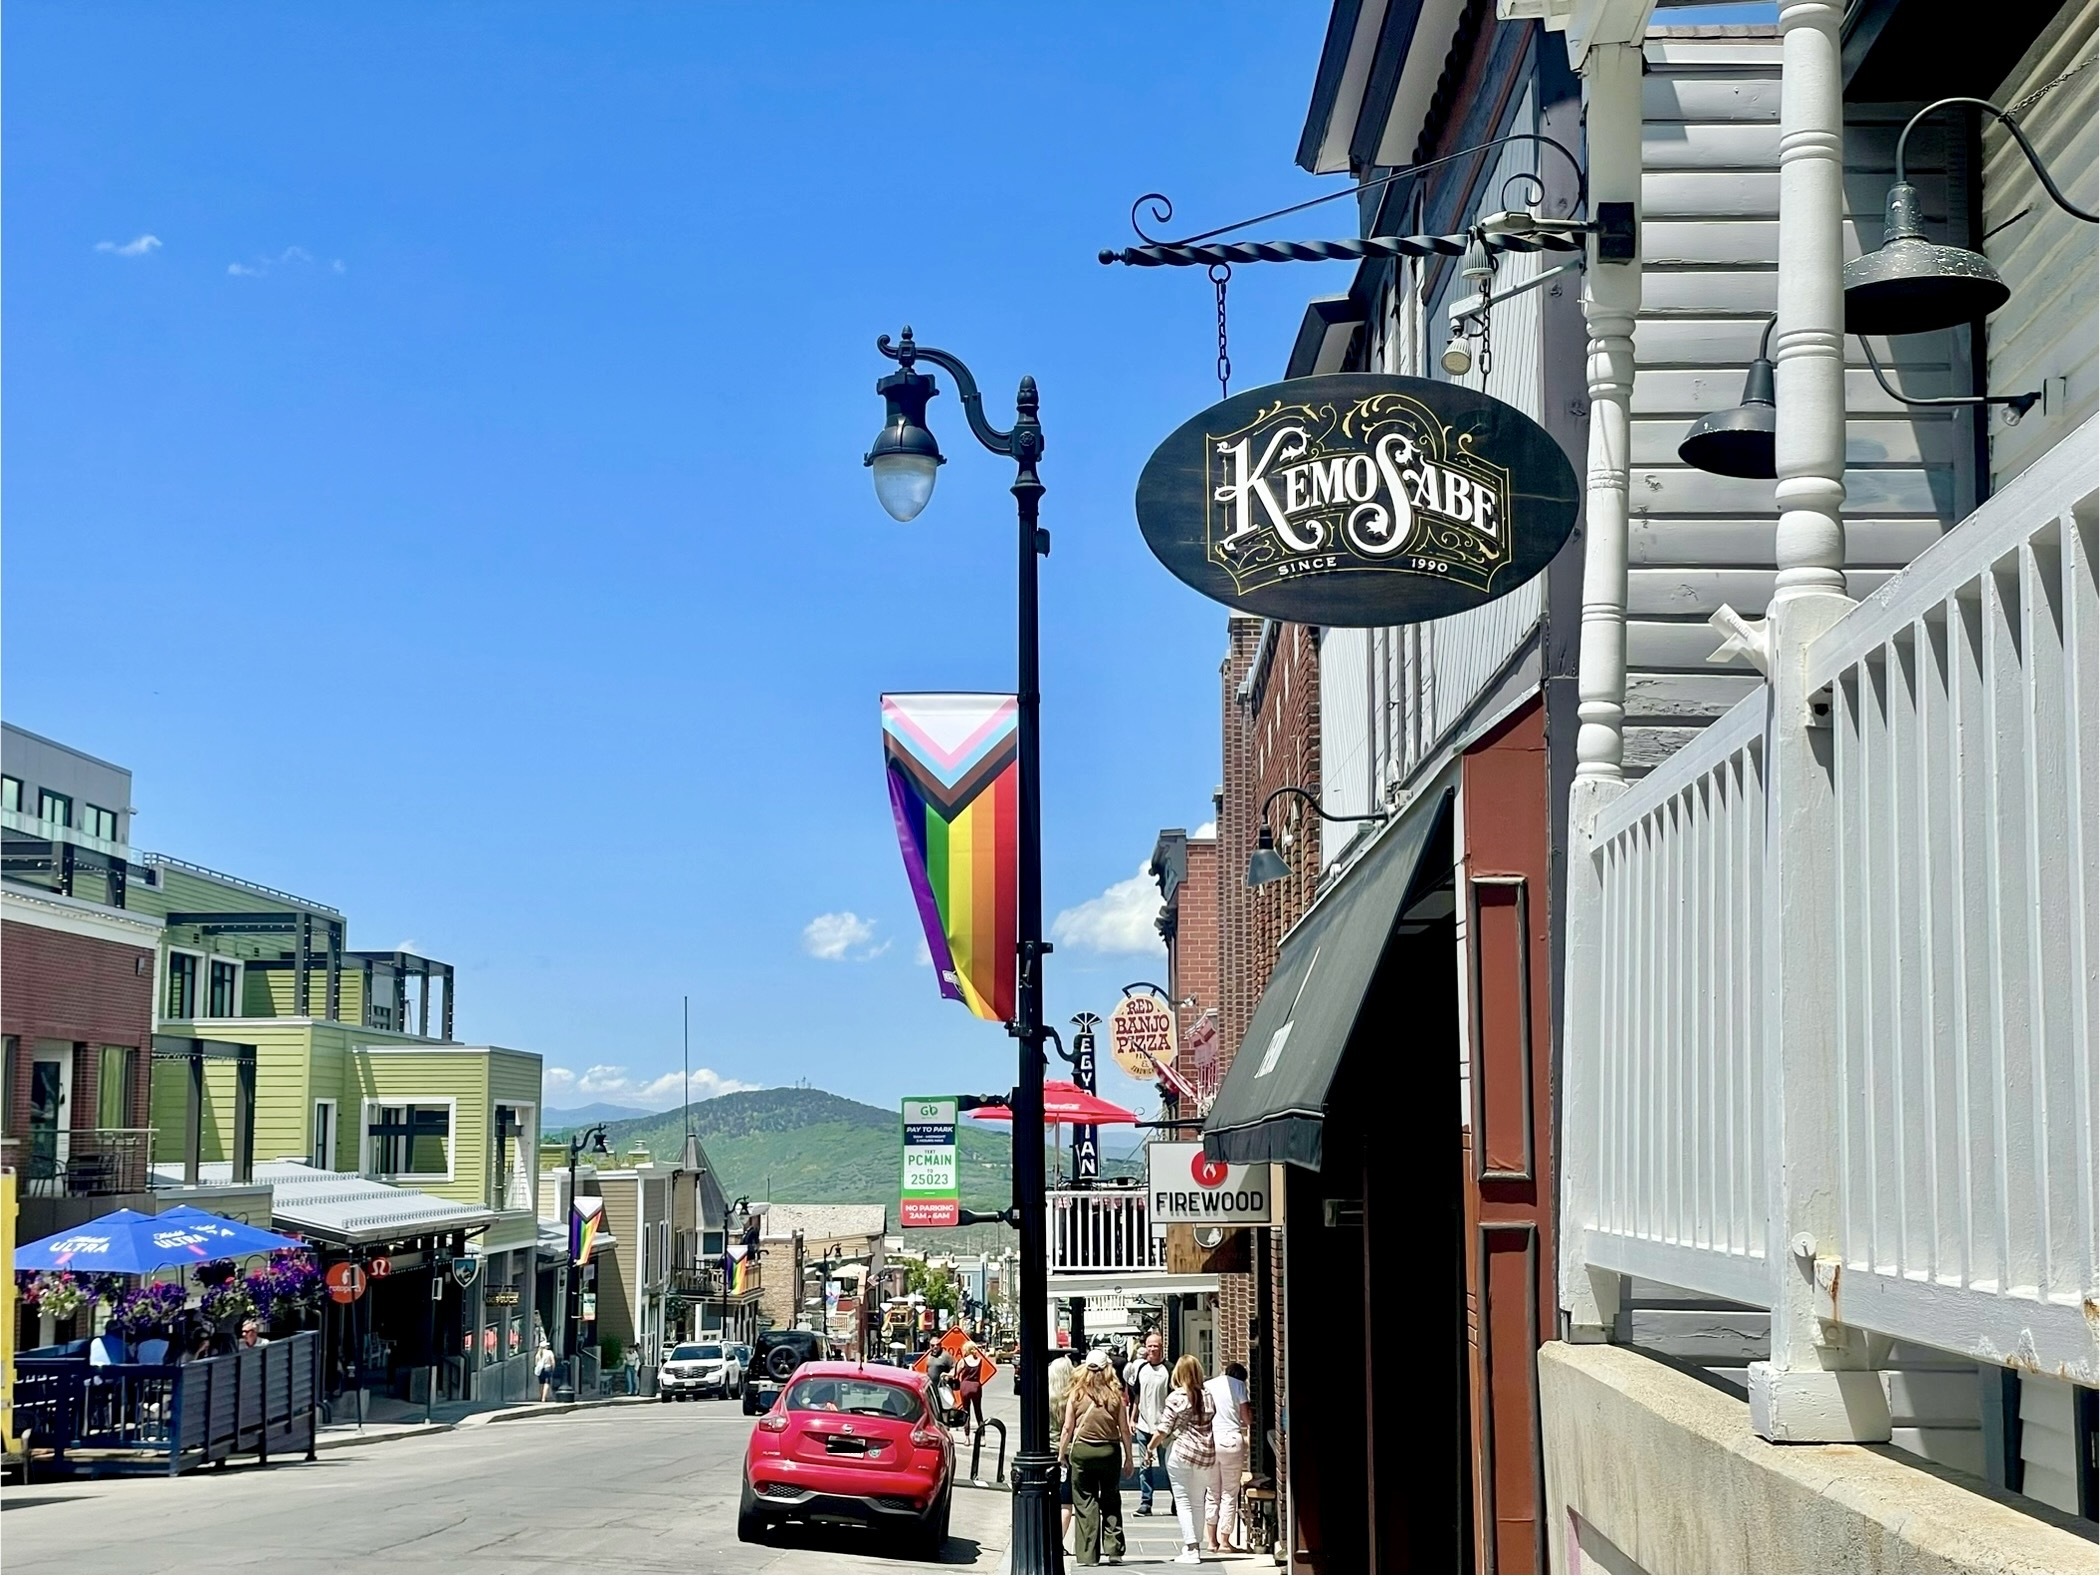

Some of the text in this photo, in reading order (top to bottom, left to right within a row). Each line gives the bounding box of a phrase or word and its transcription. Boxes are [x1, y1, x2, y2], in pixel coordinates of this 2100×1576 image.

[1278, 556, 1448, 576] SINCE 1990
[1126, 998, 1154, 1015] RED
[1115, 1014, 1170, 1034] BANJO
[1116, 1033, 1171, 1053] PIZZA
[1080, 1037, 1095, 1174] EGYIAN
[908, 1154, 952, 1166] PCMAIN
[911, 1173, 948, 1185] 25023
[905, 1204, 954, 1212] NO PARKING
[1156, 1191, 1263, 1212] FIREWOOD
[49, 1241, 110, 1253] ULTRA
[153, 1233, 209, 1249] ULTRA
